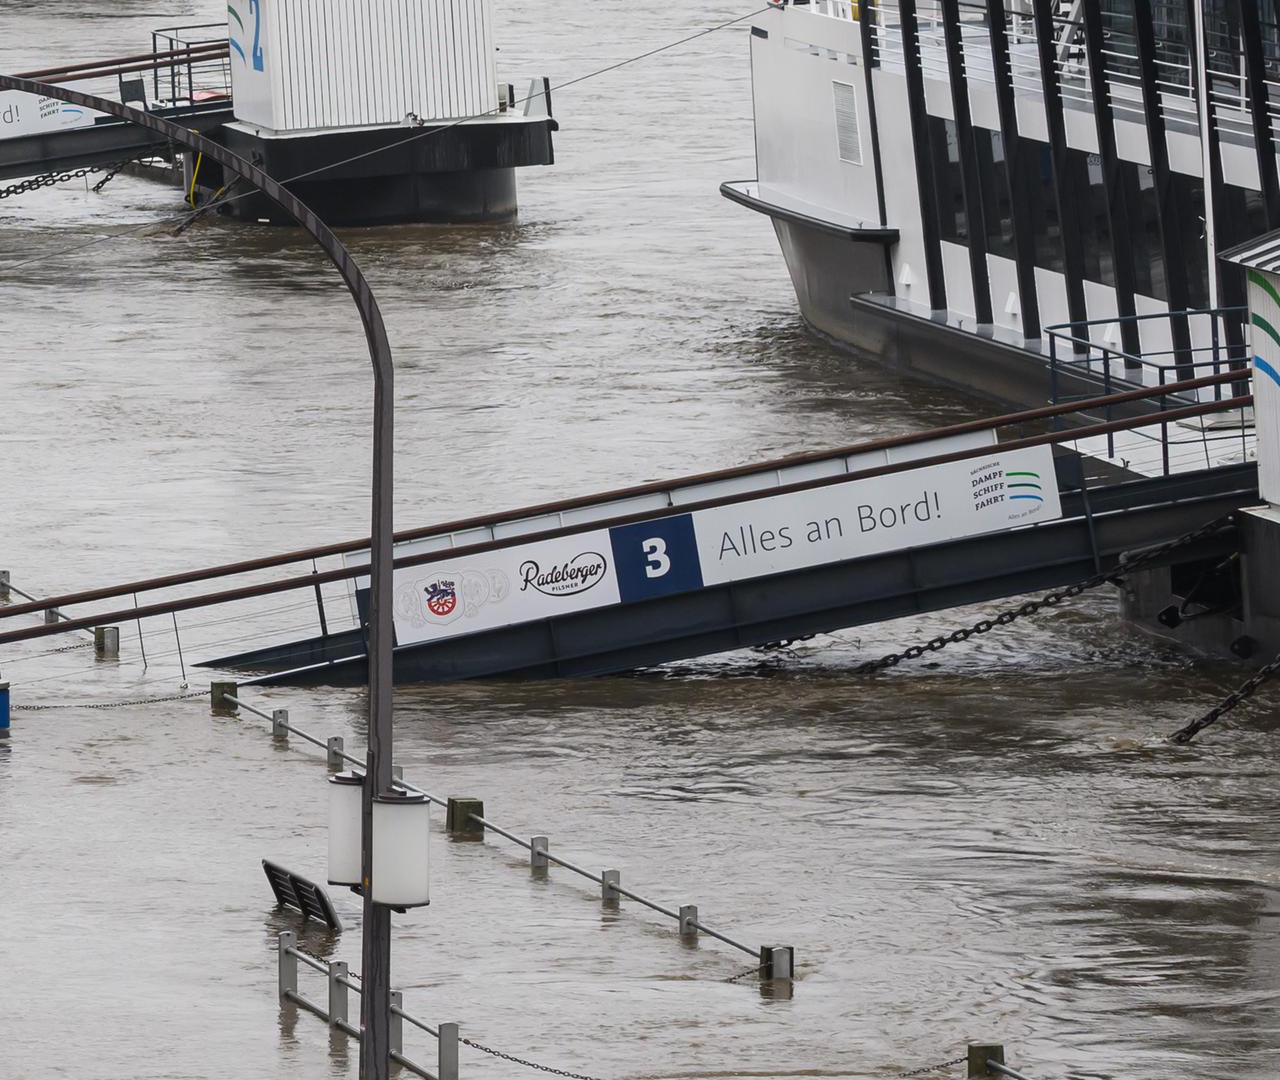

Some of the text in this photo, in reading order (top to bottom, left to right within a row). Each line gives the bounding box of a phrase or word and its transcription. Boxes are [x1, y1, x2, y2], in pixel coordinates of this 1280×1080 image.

[39, 101, 59, 112] SCHIFF
[40, 108, 60, 119] FAHRT
[971, 470, 1004, 487] DAMPF
[973, 482, 1005, 500] SCHIFF
[975, 495, 1005, 511] FAHRT
[1008, 512, 1021, 520] Alles
[719, 490, 942, 561] Alles an Bord!
[641, 537, 671, 579] 3
[519, 551, 607, 597] Radeberger
[551, 582, 579, 592] PILSNER
